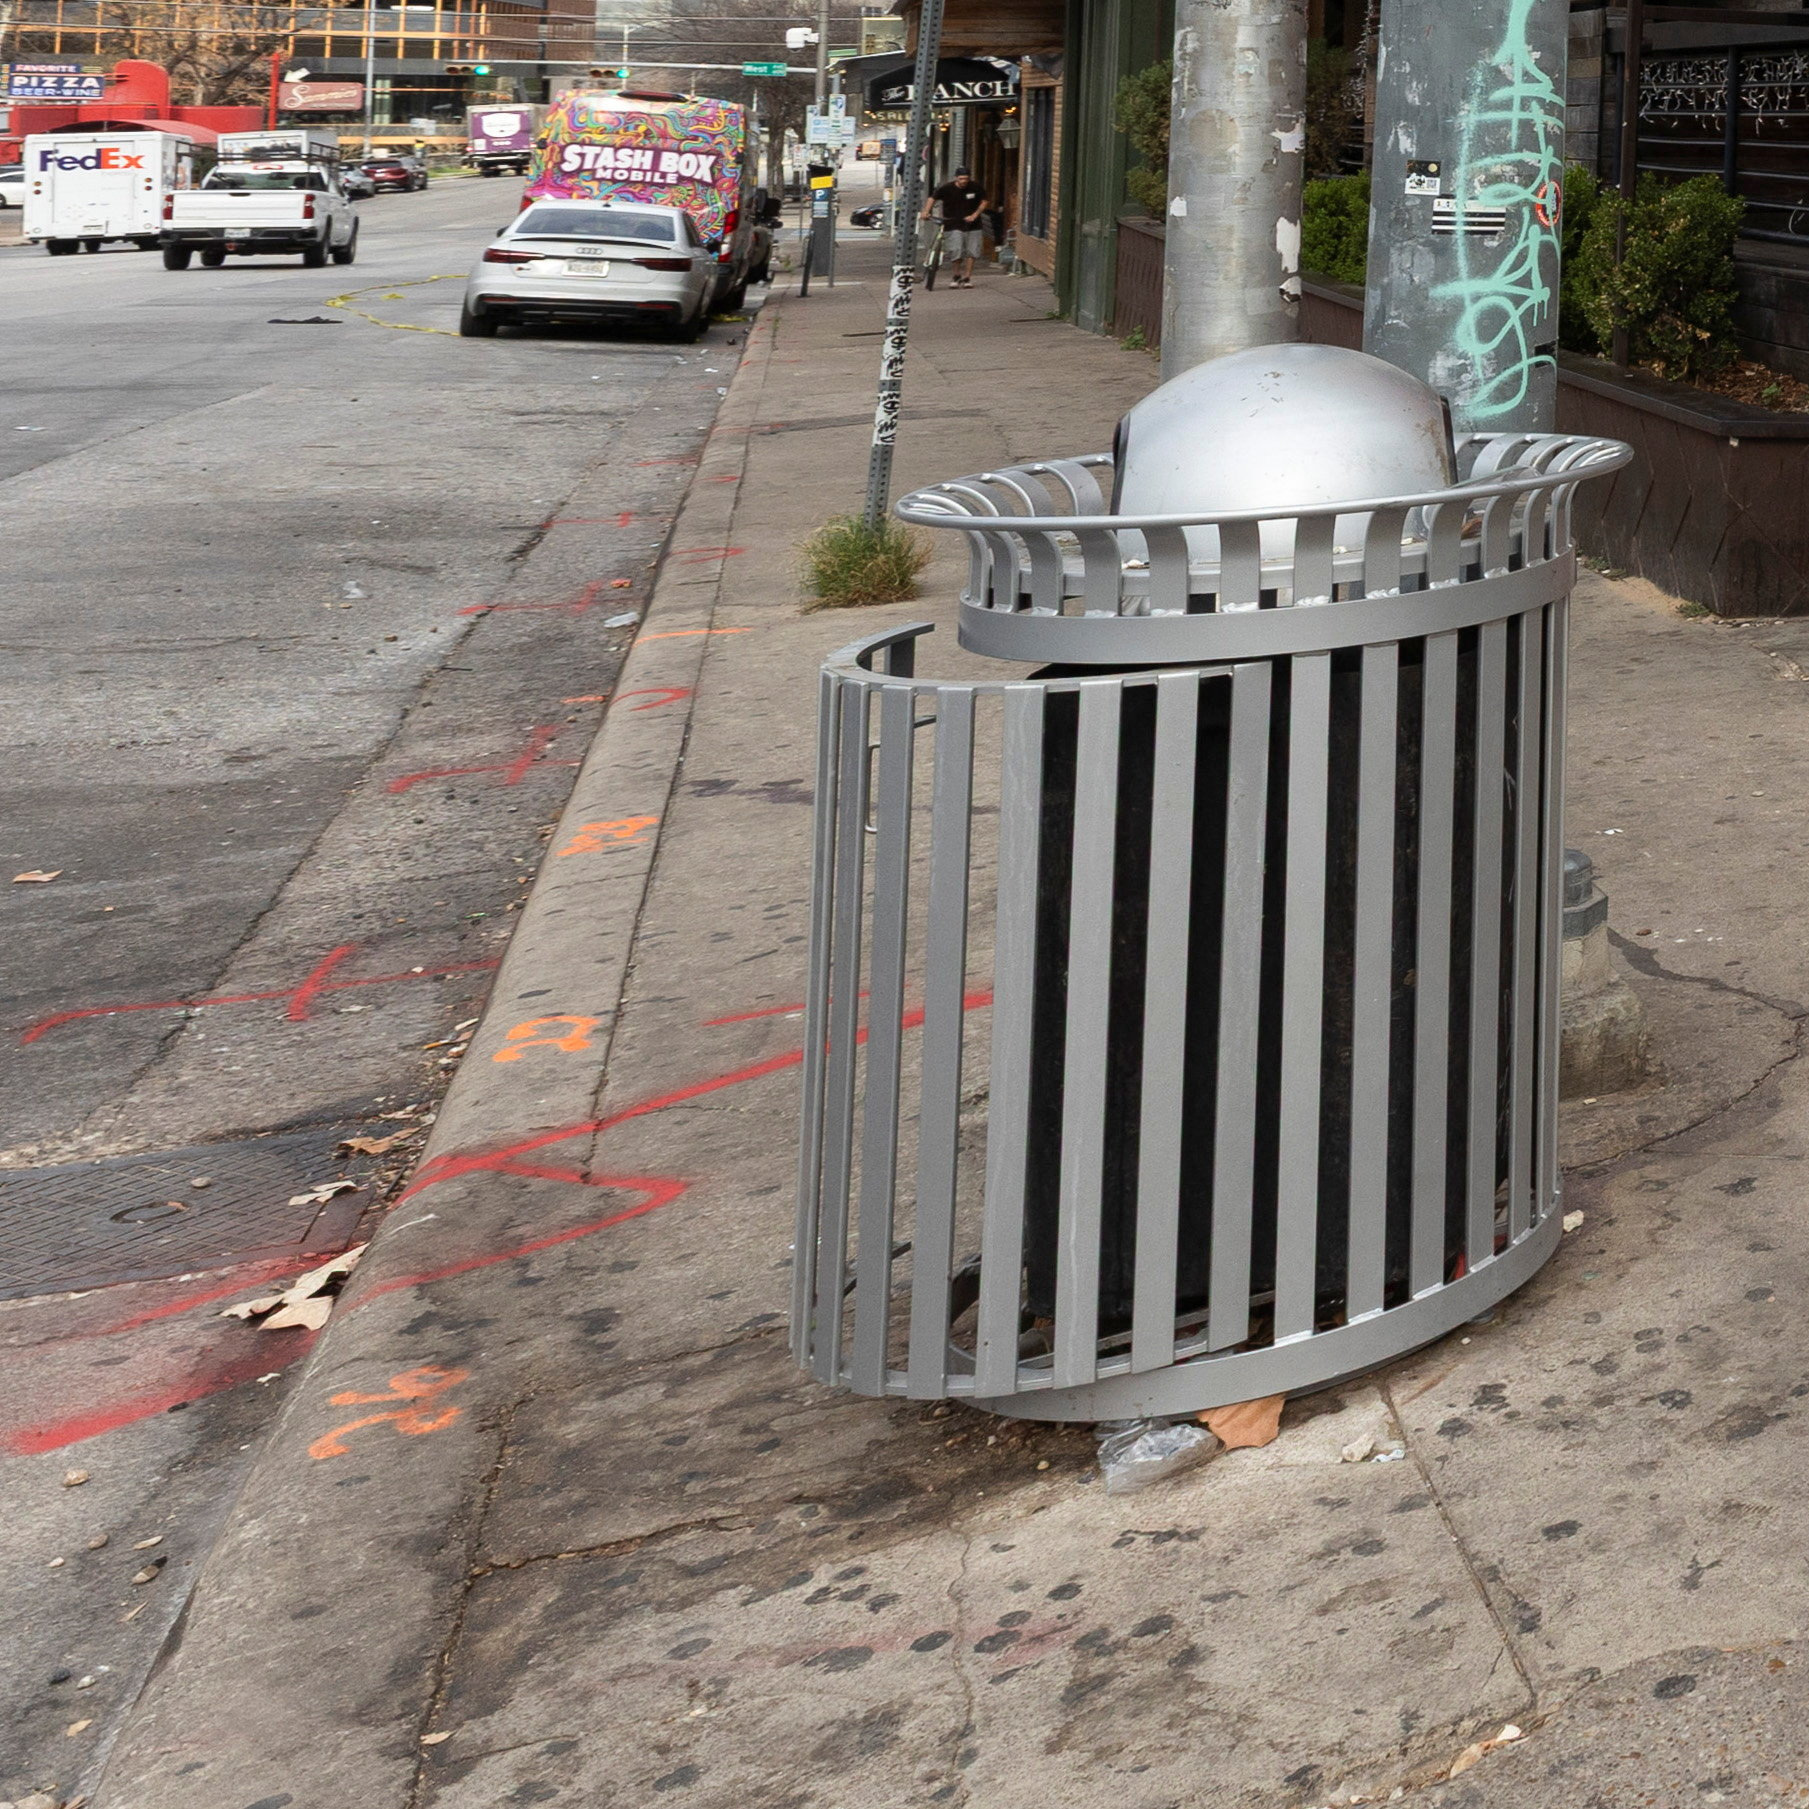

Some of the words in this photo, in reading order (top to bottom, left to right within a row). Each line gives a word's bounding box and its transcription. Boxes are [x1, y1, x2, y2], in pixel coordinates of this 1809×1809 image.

[13, 76, 100, 88] PIZZA
[39, 147, 145, 172] FedEx
[560, 144, 653, 172] STASH
[659, 151, 717, 183] BOX
[595, 168, 678, 184] MOBILE
